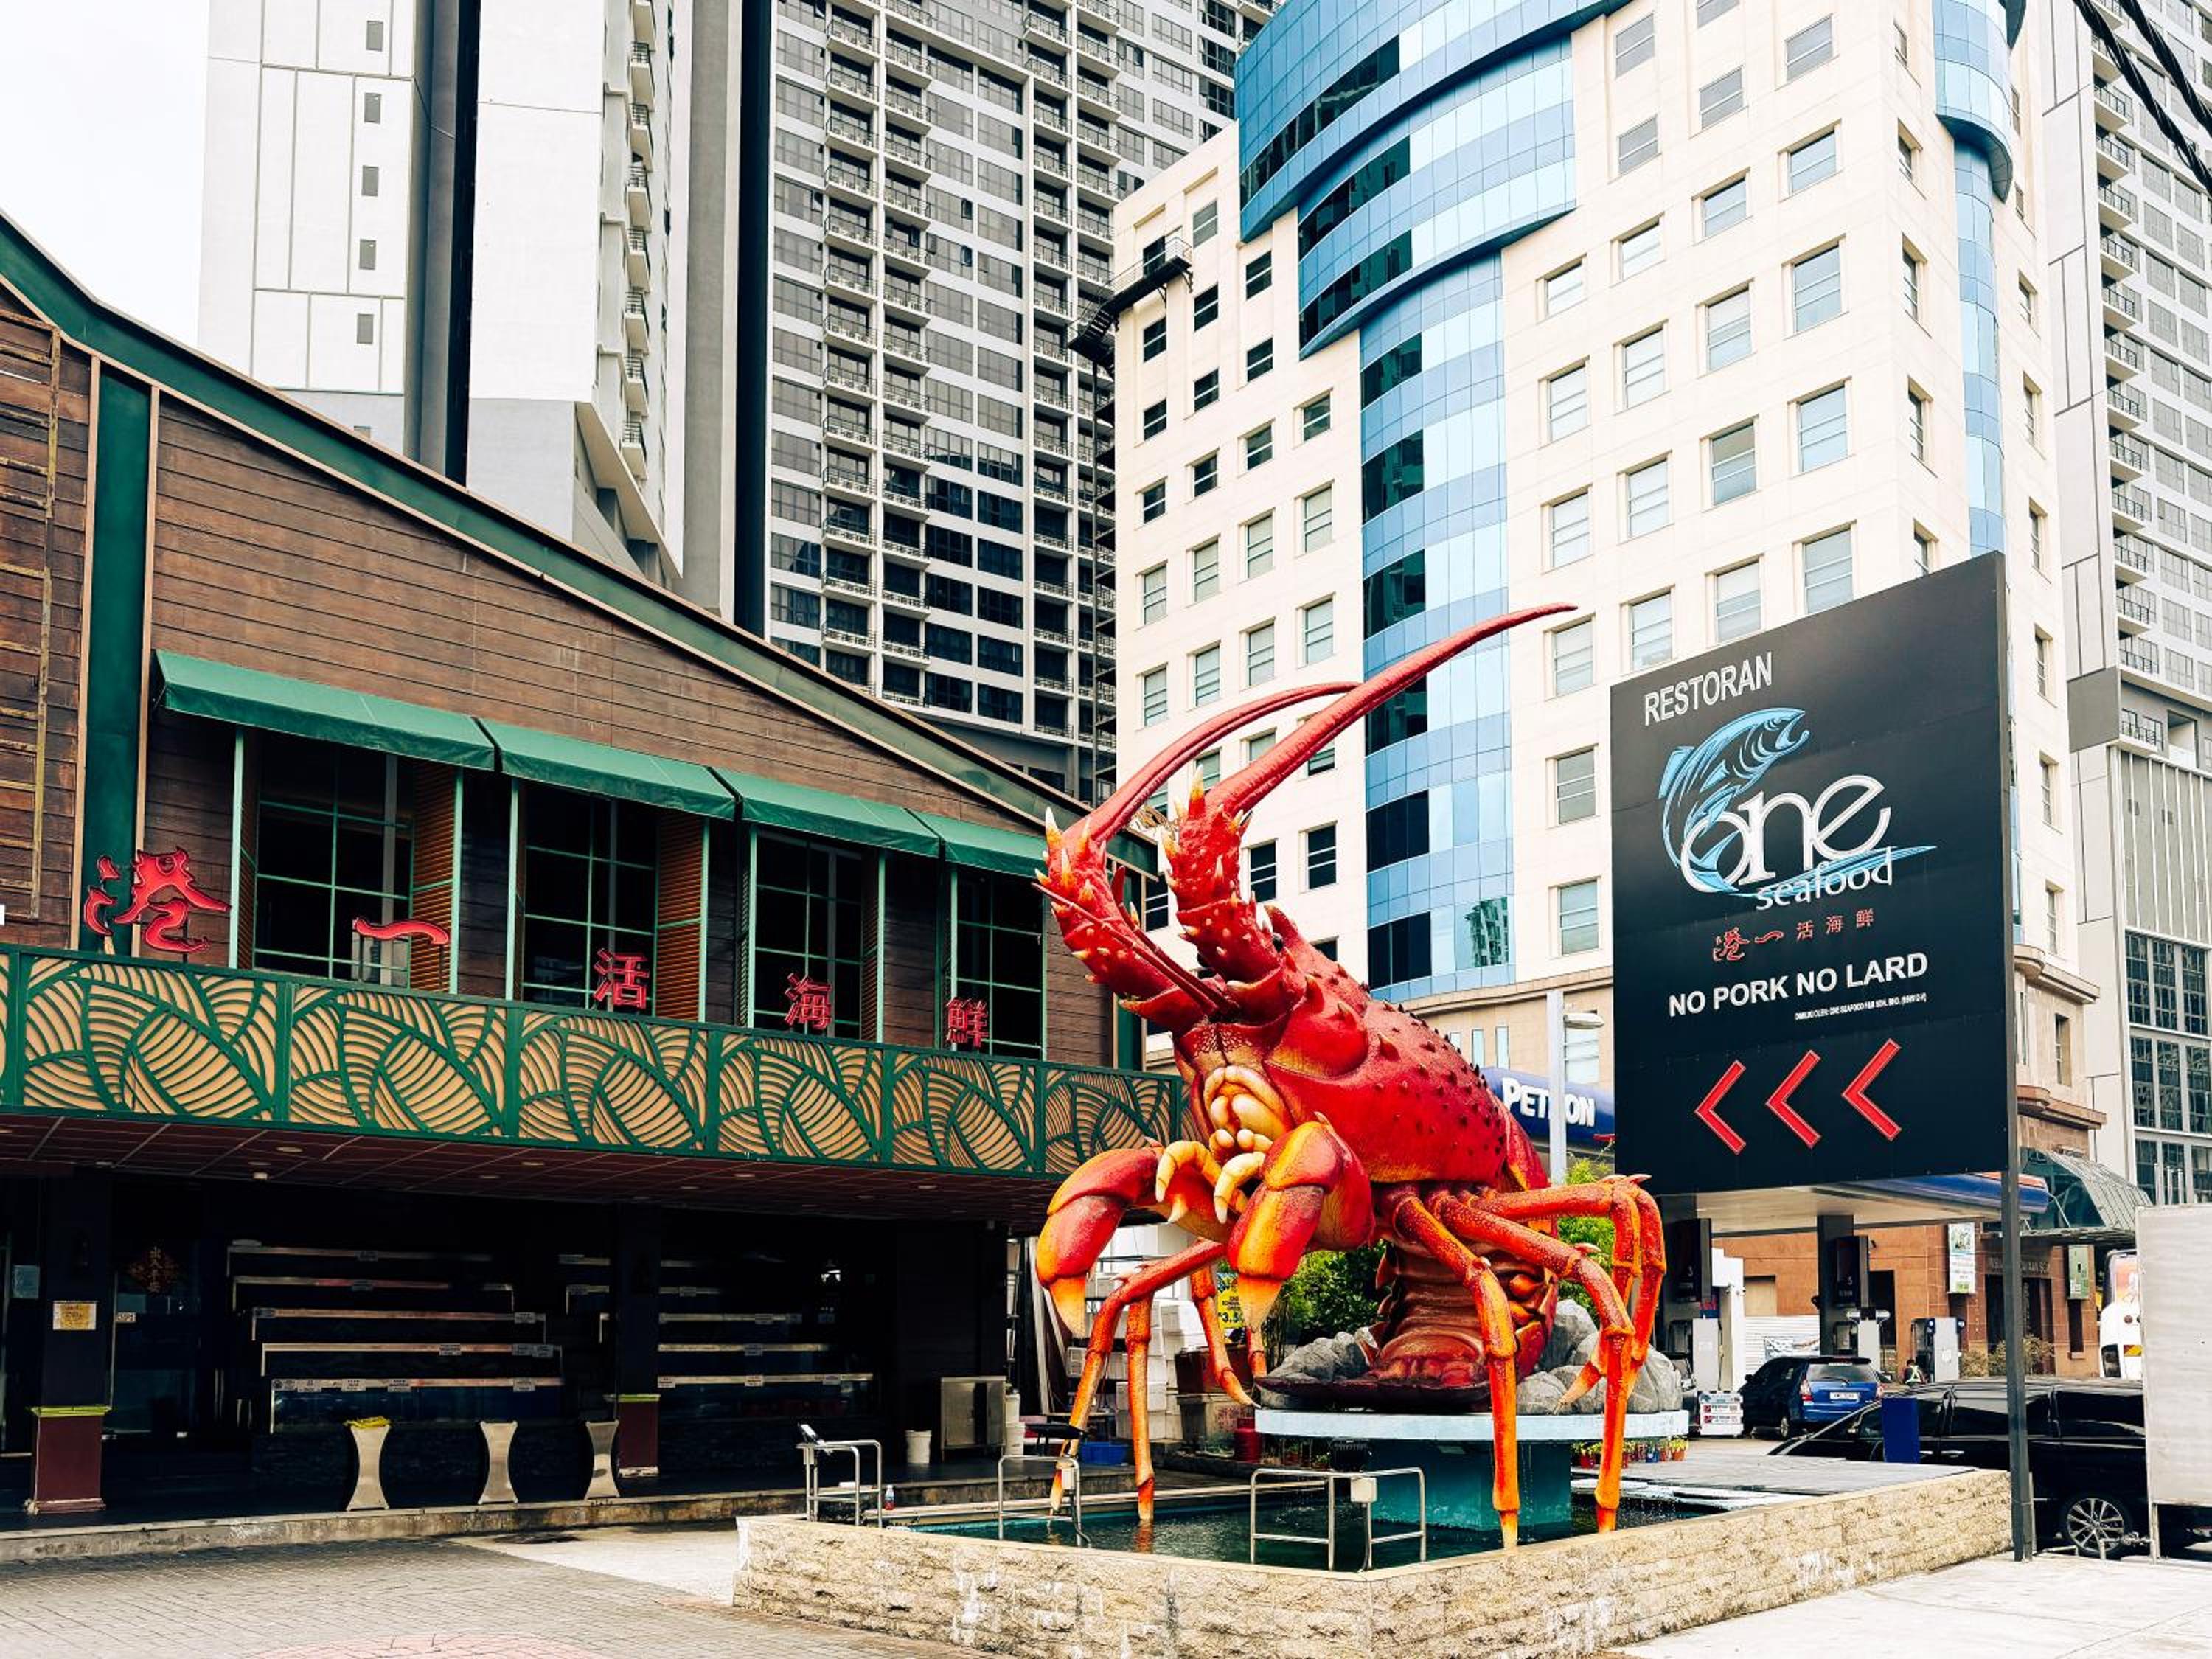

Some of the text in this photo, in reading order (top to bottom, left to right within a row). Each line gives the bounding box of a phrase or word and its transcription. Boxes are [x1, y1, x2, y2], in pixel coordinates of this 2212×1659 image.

[1644, 651, 1773, 726] RESTORAN
[1756, 846, 1893, 911] seafood
[1669, 952, 1929, 1018] NO PORK NO LARD
[1840, 1001, 1865, 1014] SEAFOOD
[1503, 1077, 1595, 1127] PETON
